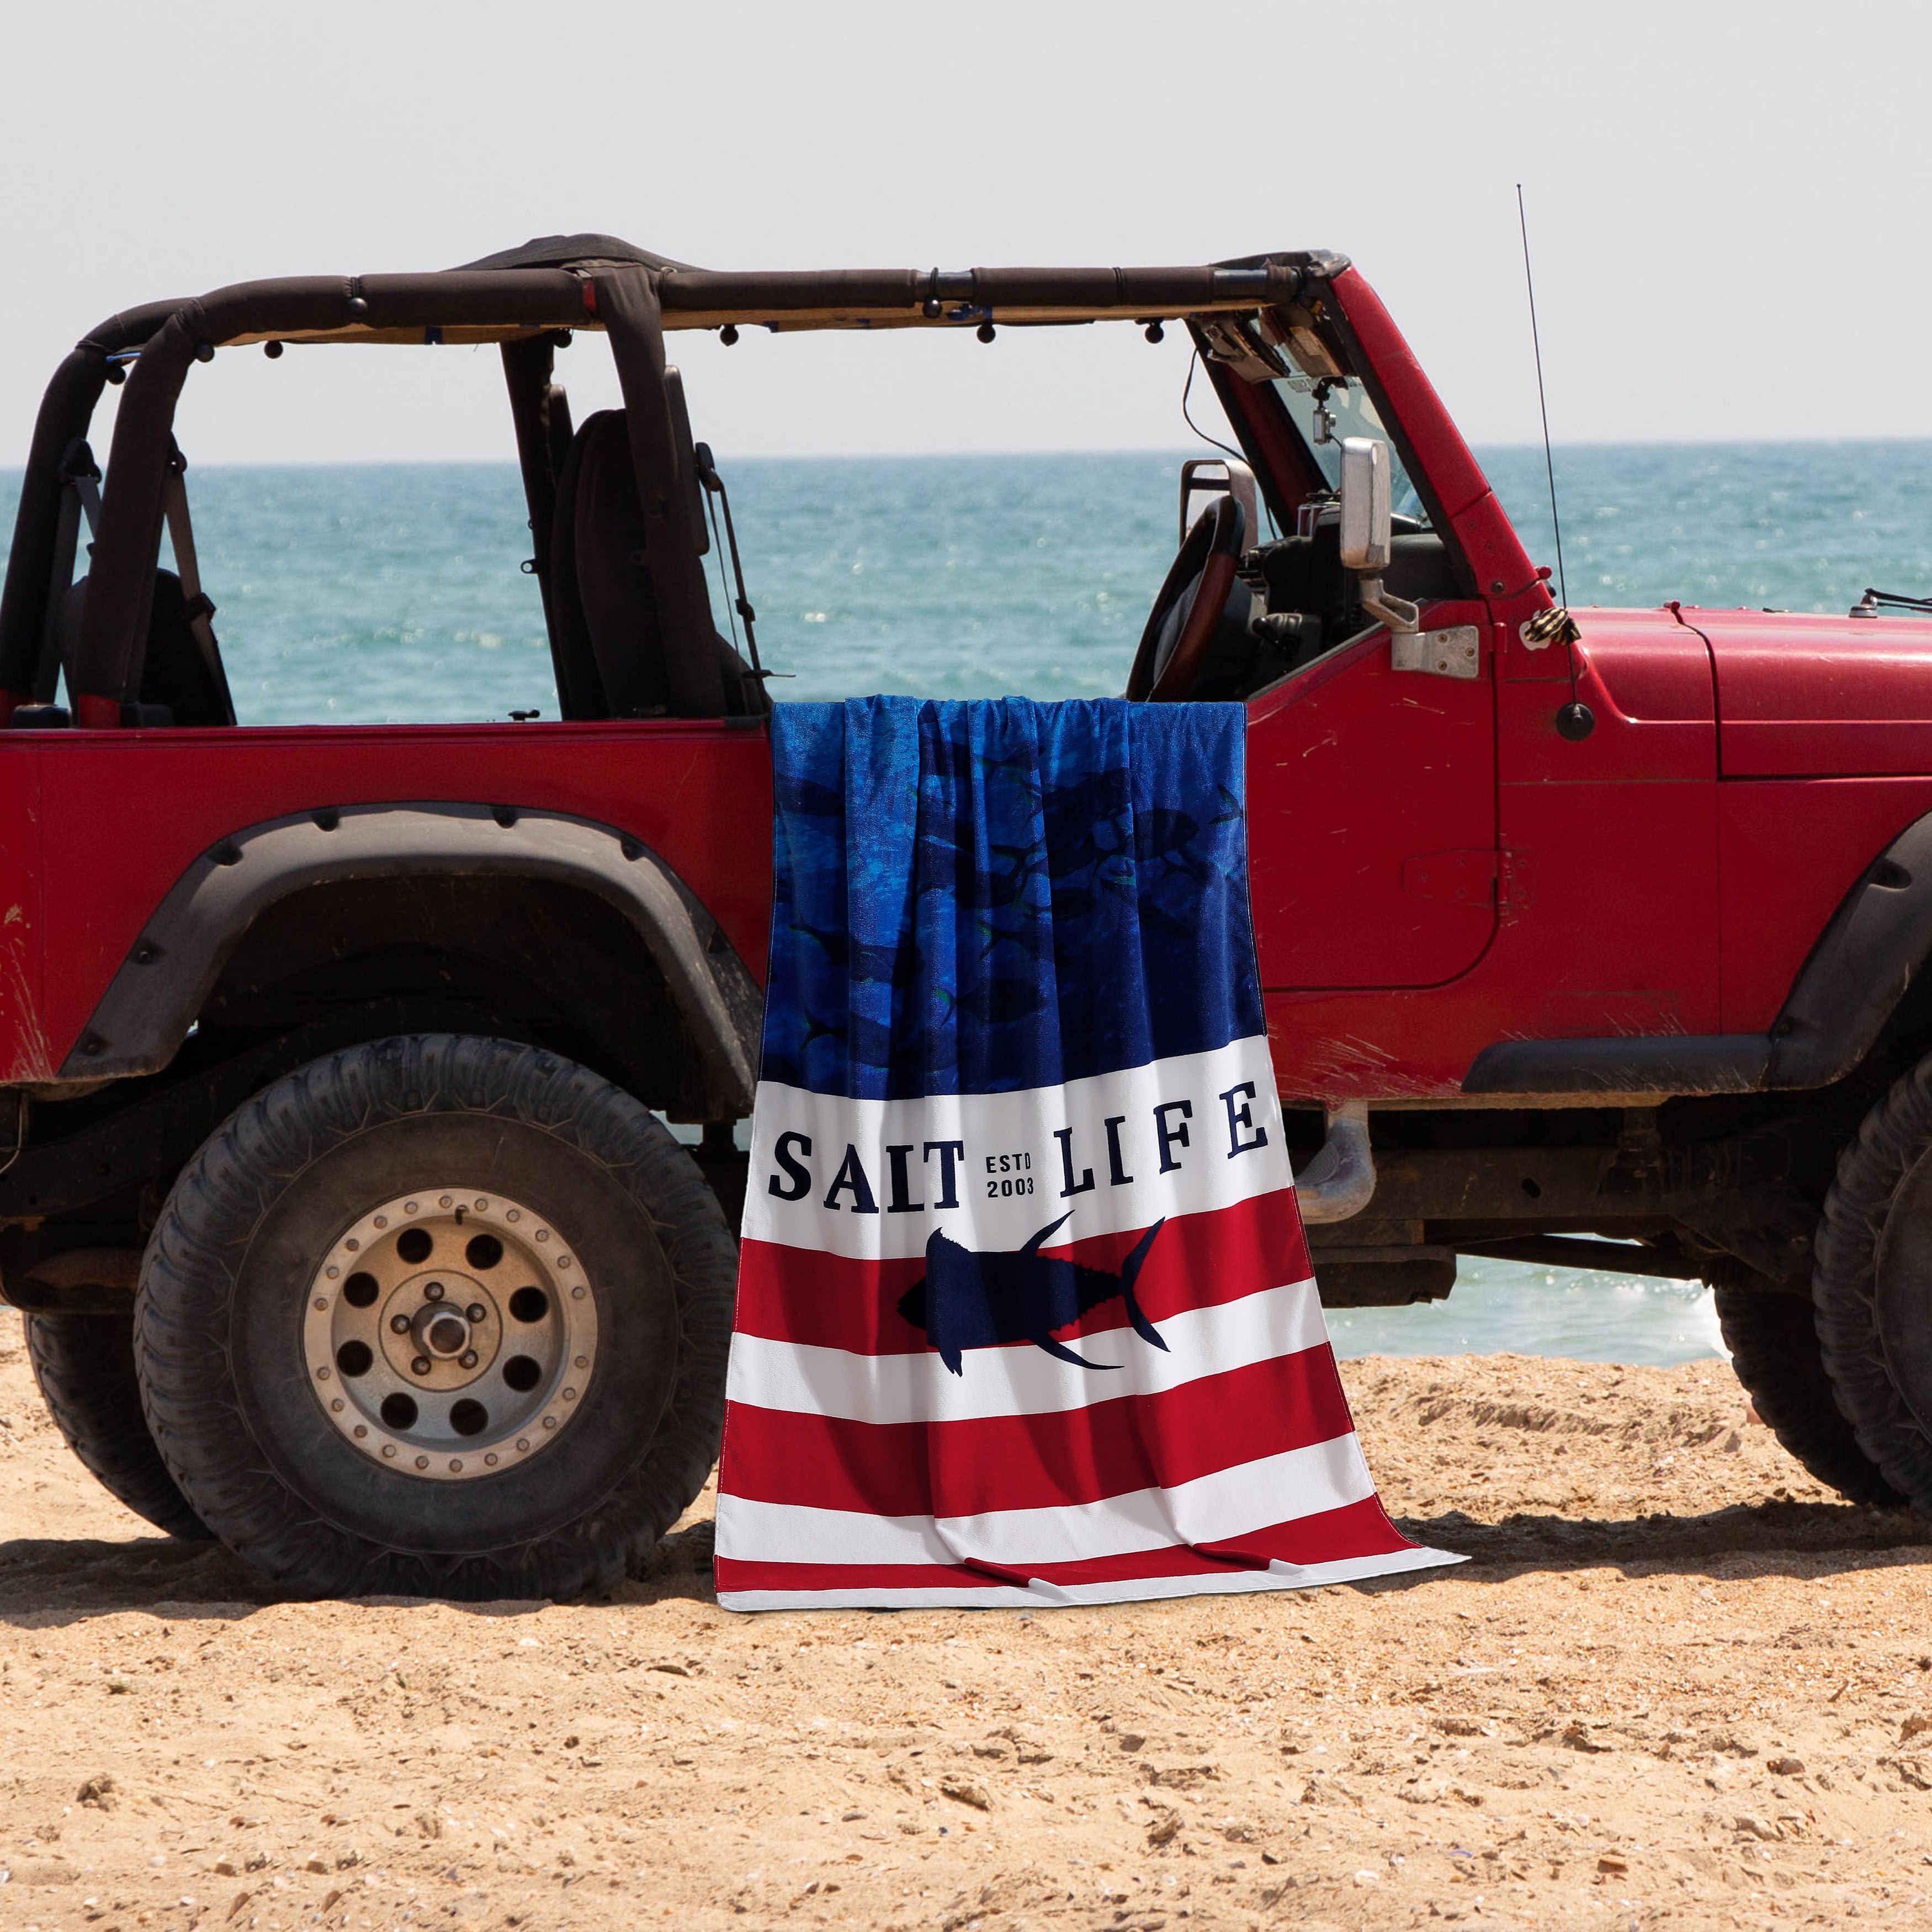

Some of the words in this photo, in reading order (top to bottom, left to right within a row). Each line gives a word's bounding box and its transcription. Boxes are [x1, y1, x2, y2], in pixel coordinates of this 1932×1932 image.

[767, 1130, 965, 1214] SALT
[1053, 1080, 1269, 1199] LIFE
[985, 1151, 1032, 1174] ESTD
[986, 1176, 1034, 1198] 2003
